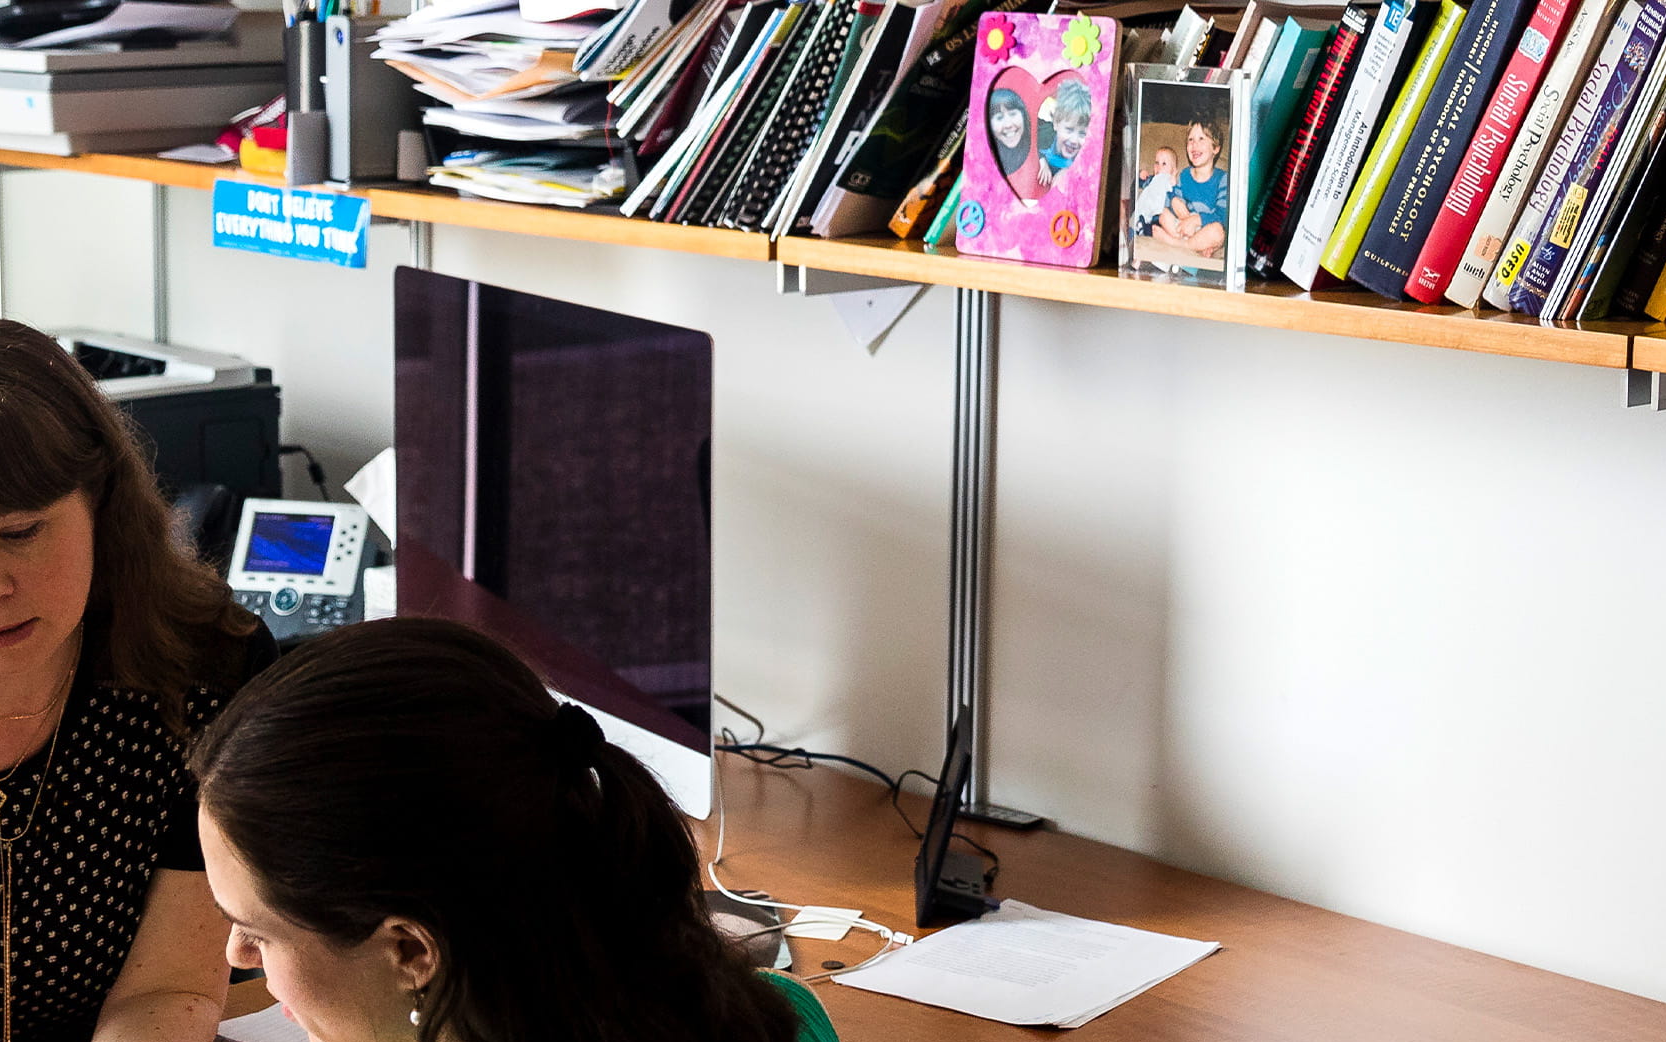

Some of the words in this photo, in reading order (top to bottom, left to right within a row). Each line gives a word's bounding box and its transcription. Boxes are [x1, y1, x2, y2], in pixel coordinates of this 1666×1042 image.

[1474, 19, 1499, 65] HIGGINS
[1435, 68, 1467, 128] HANDBOOK
[1445, 74, 1478, 132] SOCIAL
[1486, 72, 1530, 129] Social
[1528, 83, 1561, 130] Social
[1574, 57, 1615, 114] Social
[1334, 108, 1362, 165] Management
[1357, 121, 1369, 135] An
[1428, 128, 1439, 144] OF
[1335, 136, 1364, 189] Introduction
[1396, 135, 1452, 241] PSYCHOLOGY
[1414, 144, 1432, 175] BASIC
[1443, 123, 1506, 218] Psychology
[1496, 126, 1542, 204] Psychology
[1524, 114, 1587, 214] Psychology
[1331, 189, 1343, 201] to
[1387, 176, 1418, 234] PRINCIPLES
[216, 212, 294, 244] EVERYTHING
[295, 223, 321, 248] YOU
[1501, 243, 1526, 279] USED
